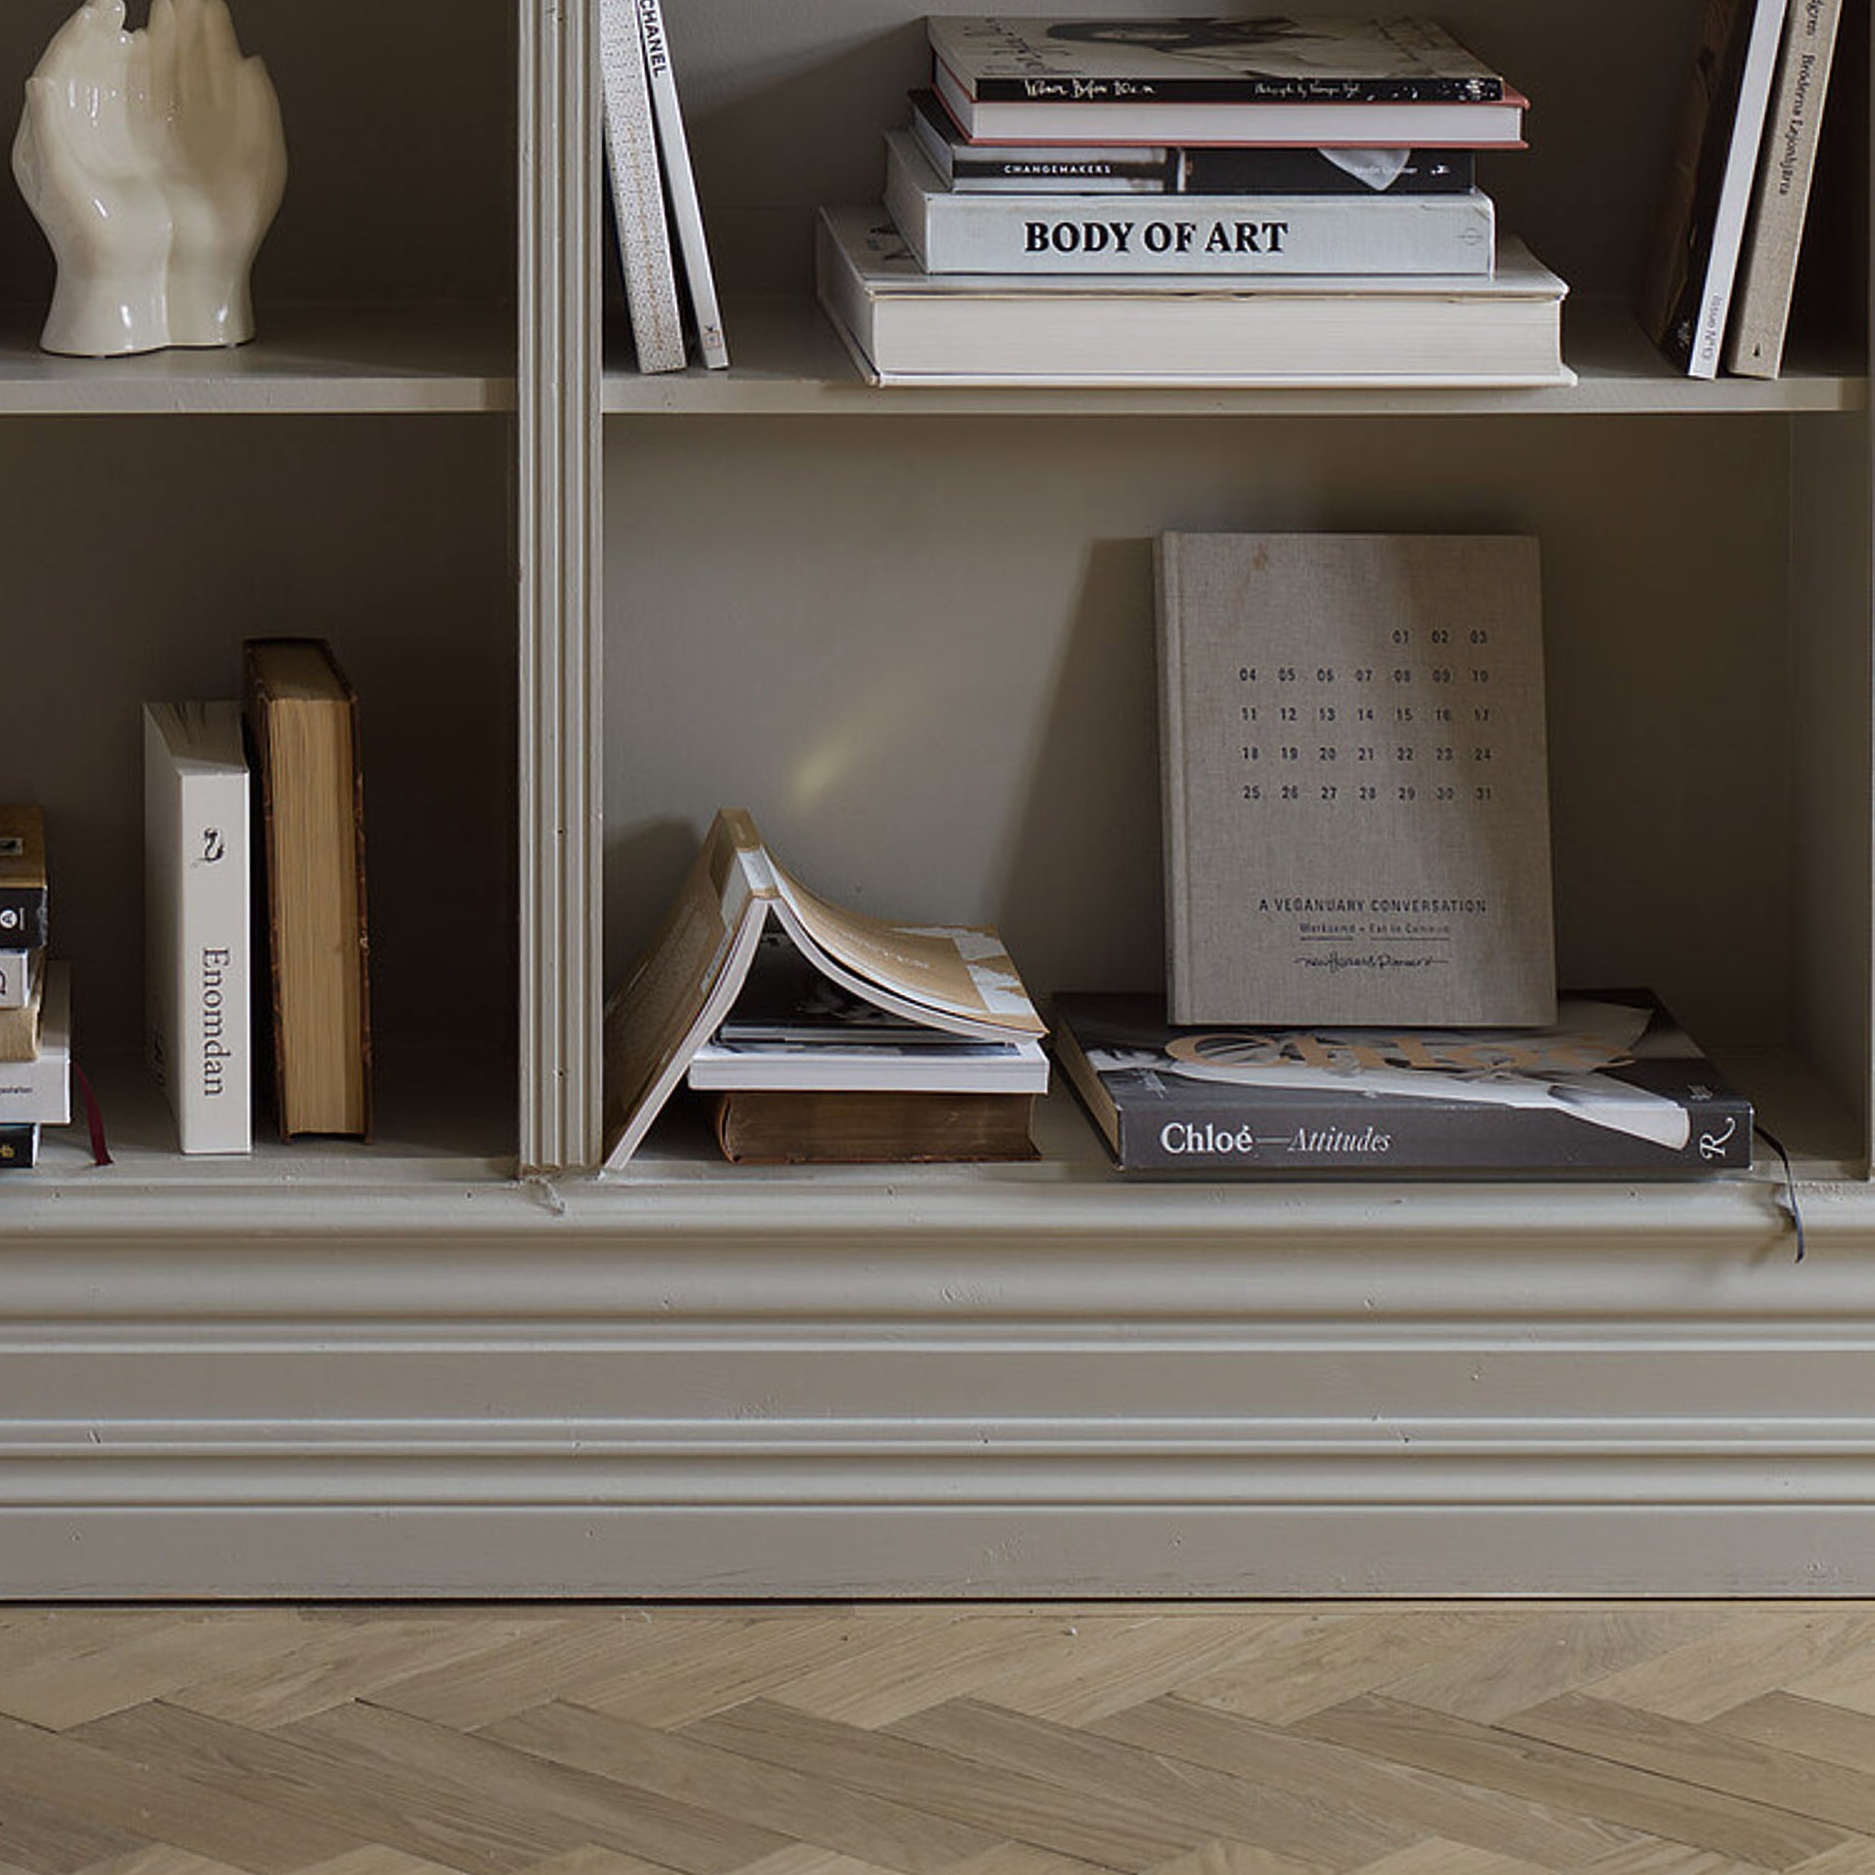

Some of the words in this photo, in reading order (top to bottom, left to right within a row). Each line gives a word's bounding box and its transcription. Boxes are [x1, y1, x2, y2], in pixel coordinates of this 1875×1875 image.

[1003, 165, 1112, 174] CHANGEMAKERS
[1024, 221, 1135, 253] BODY
[1143, 221, 1197, 253] OF
[1204, 221, 1289, 253] ART
[1392, 630, 1409, 644] 01
[1431, 630, 1449, 644] 02
[1470, 630, 1487, 644] 03
[1239, 668, 1257, 682] 04
[1278, 668, 1296, 682] 05
[1316, 668, 1335, 682] 06
[1355, 668, 1373, 682] 07
[1394, 668, 1411, 682] 08
[1432, 668, 1451, 682] 09
[1473, 668, 1489, 682] 10
[1242, 707, 1257, 721] 11
[1280, 707, 1297, 721] 12
[1319, 707, 1336, 721] 13
[1358, 707, 1374, 721] 14
[1396, 707, 1413, 721] 15
[1436, 707, 1451, 721] 16
[1475, 707, 1489, 721] 17
[1242, 747, 1259, 761] 18
[1281, 747, 1298, 761] 19
[1319, 747, 1336, 761] 20
[1358, 747, 1374, 761] 21
[1397, 747, 1414, 761] 22
[1436, 747, 1453, 761] 23
[1475, 747, 1491, 761] 24
[1243, 786, 1261, 800] 25
[1282, 786, 1299, 800] 26
[1321, 786, 1338, 800] 27
[1359, 786, 1376, 800] 28
[1398, 786, 1415, 800] 29
[1437, 786, 1454, 800] 30
[1476, 786, 1491, 800] 31
[1258, 899, 1269, 912] A
[1274, 898, 1365, 912] VEGANUARY
[1370, 899, 1487, 913] CONVERSATION
[203, 947, 231, 1098] Enomdan
